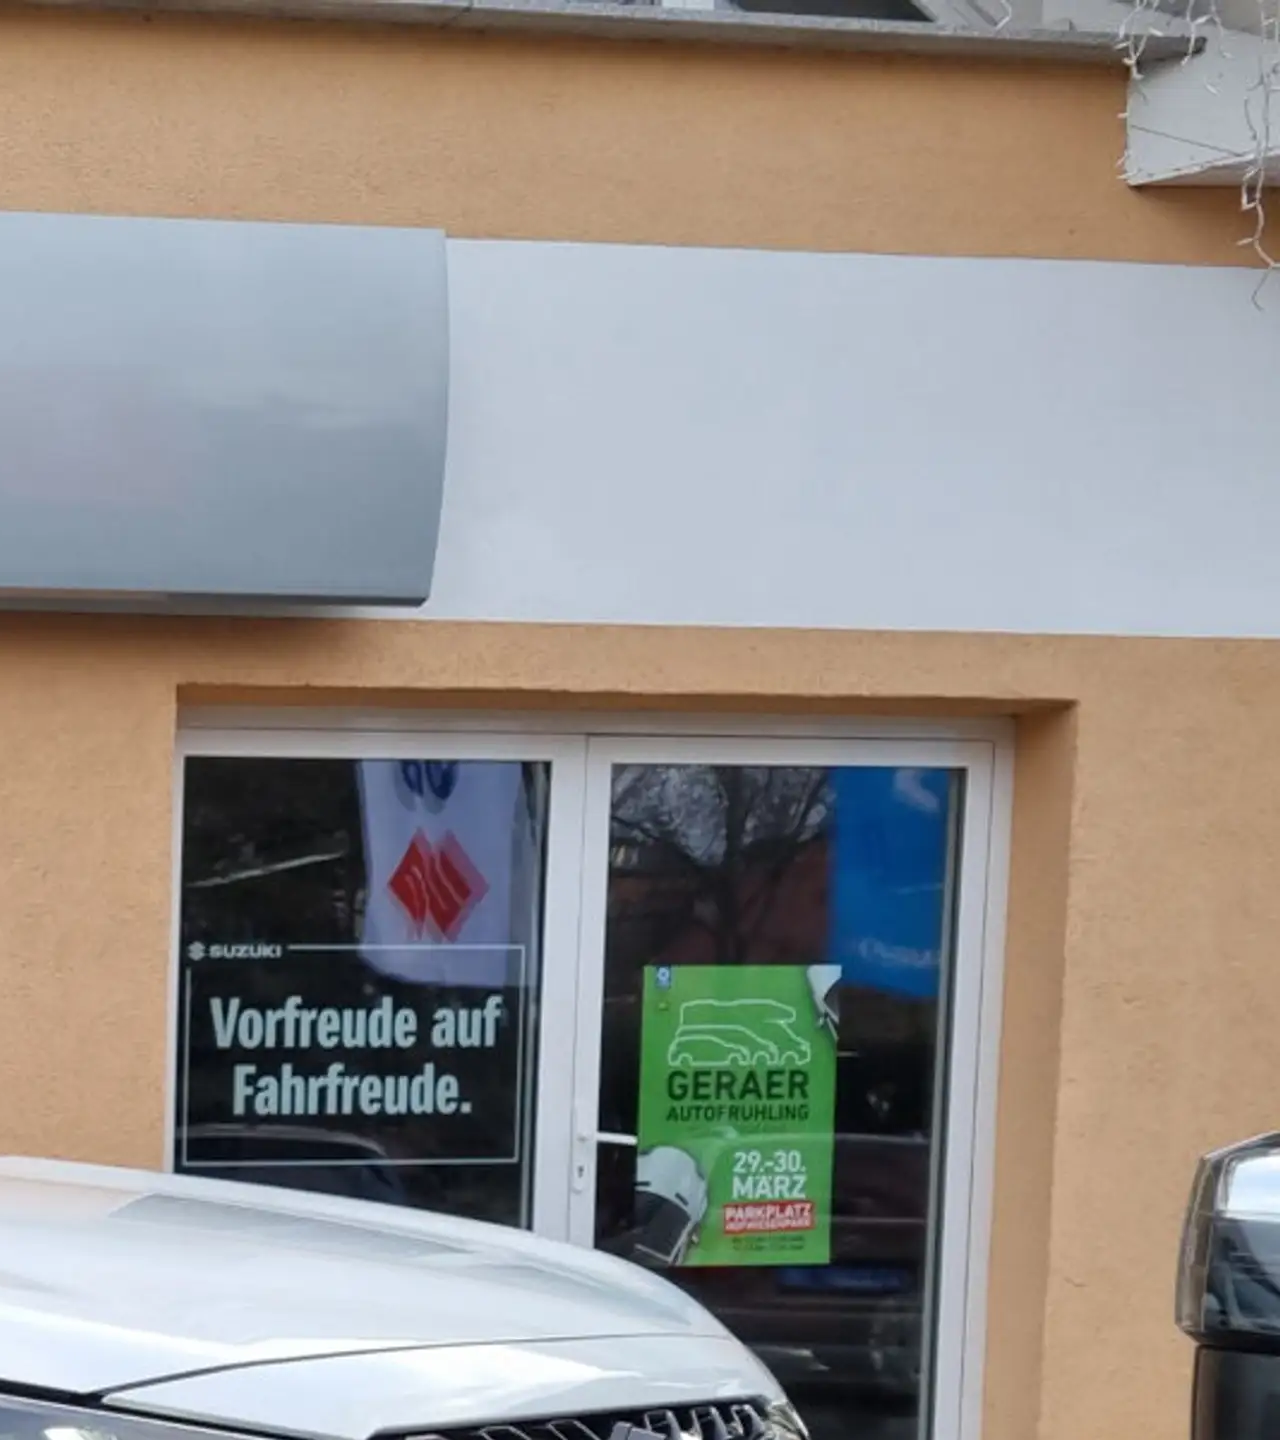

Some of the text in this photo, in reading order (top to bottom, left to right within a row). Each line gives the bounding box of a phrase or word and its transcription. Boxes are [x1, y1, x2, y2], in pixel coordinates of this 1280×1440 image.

[208, 944, 282, 959] SUZUKI
[209, 996, 504, 1048] Vorfreude auf
[233, 1062, 473, 1116] Fahrfreude.
[666, 1069, 810, 1101] GERAER
[732, 1149, 807, 1174] 29.-30.
[731, 1174, 807, 1200] MÄRZ
[724, 1202, 812, 1221] PARKPLATZ
